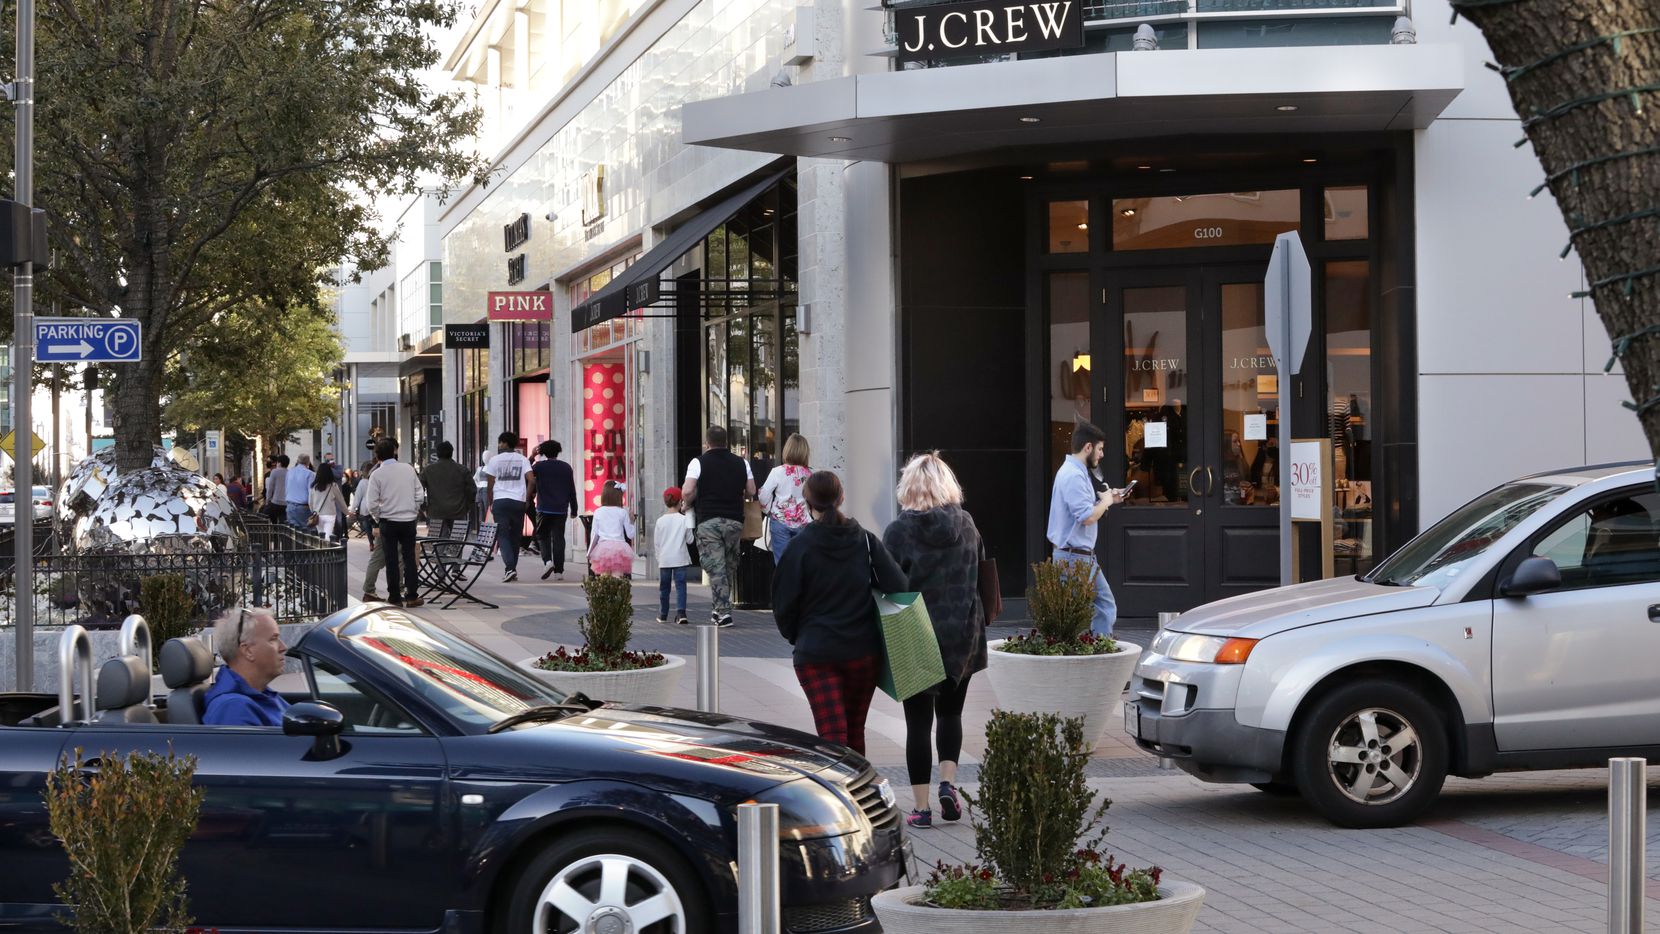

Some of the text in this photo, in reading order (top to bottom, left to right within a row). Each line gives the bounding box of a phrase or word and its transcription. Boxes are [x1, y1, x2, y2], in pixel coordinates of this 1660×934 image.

[904, 1, 1072, 52] J.CREW
[1194, 227, 1223, 239] G100
[494, 295, 546, 311] PINK
[38, 325, 104, 340] PARKING
[114, 331, 128, 352] P
[1132, 358, 1180, 371] J.CREW
[1229, 356, 1277, 369] J.CREW
[1291, 462, 1317, 486] 30%
